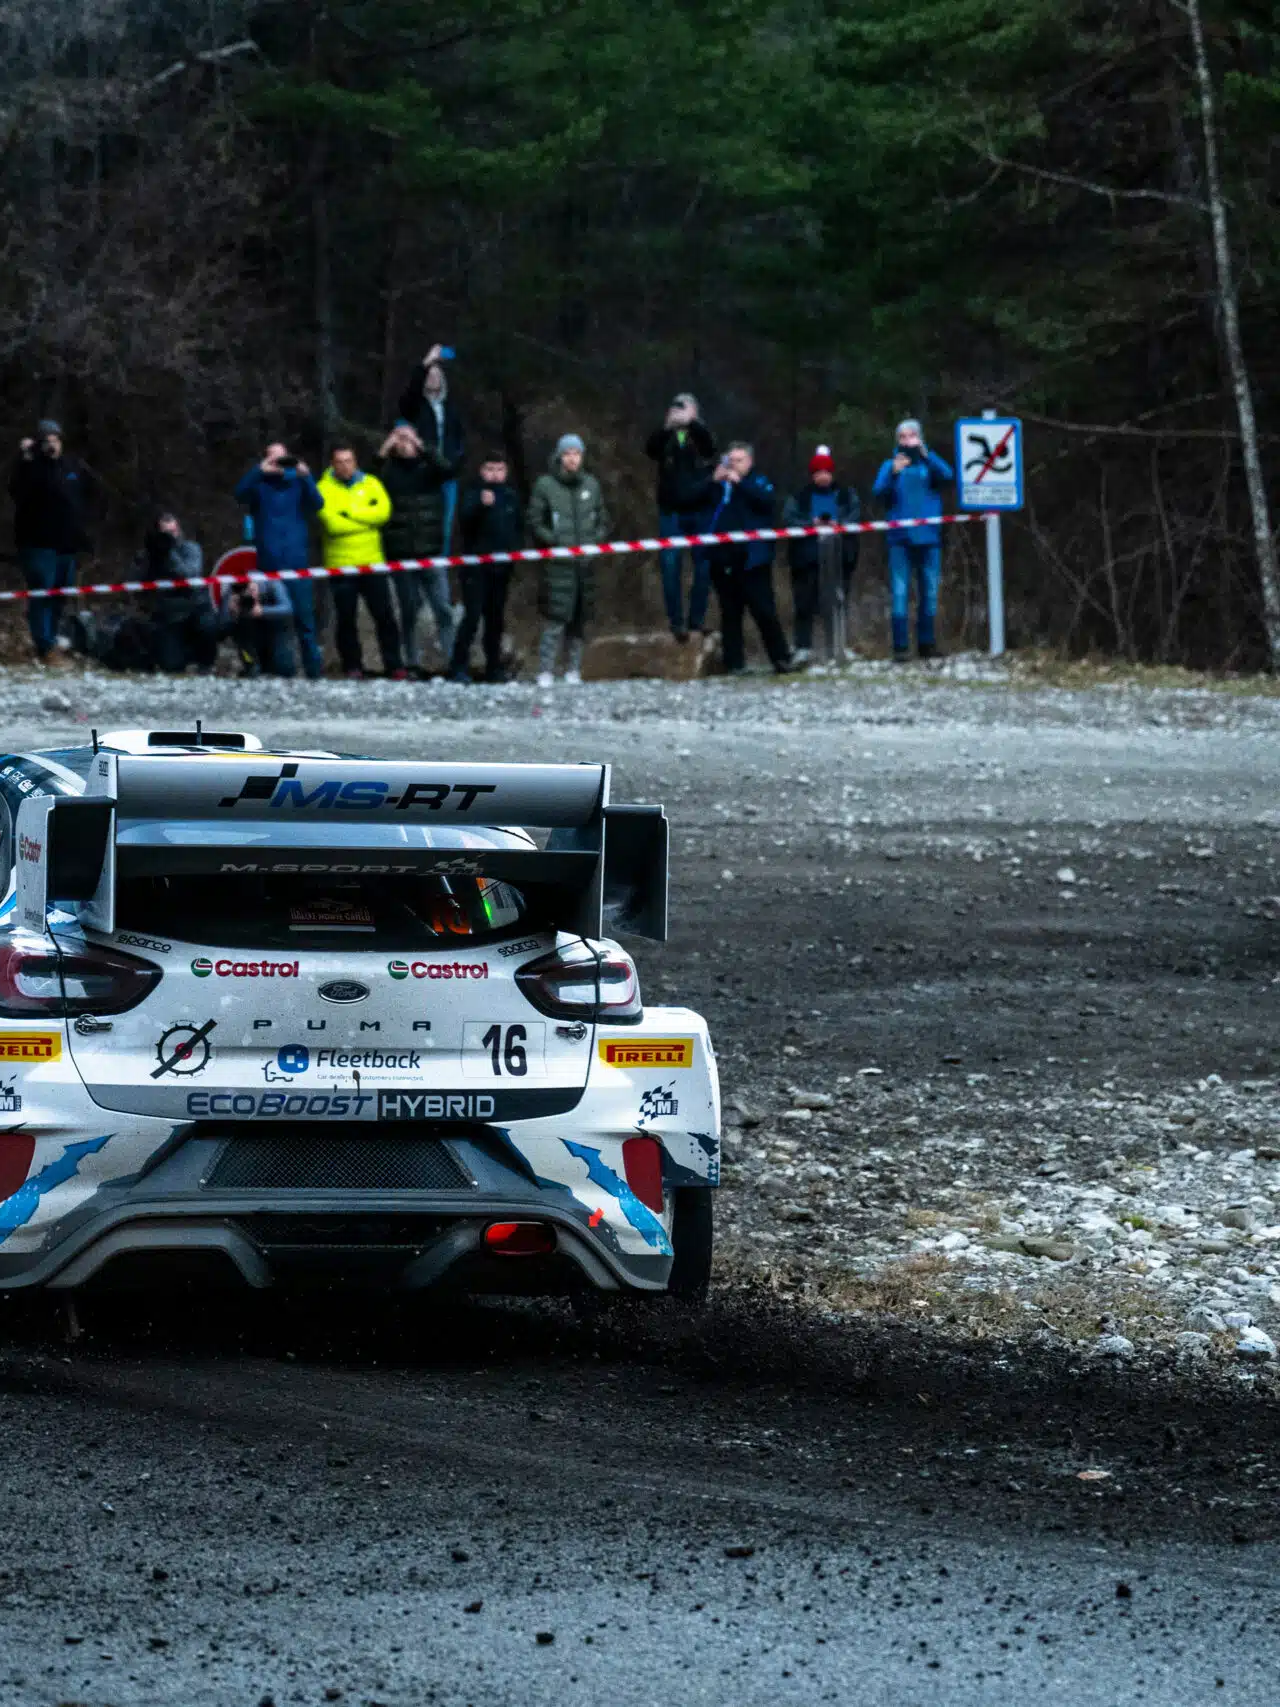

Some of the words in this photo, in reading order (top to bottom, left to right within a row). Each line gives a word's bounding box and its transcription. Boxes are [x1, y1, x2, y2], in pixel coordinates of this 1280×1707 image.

[270, 780, 497, 811] MS-RT
[220, 863, 417, 874] M-SPORT
[117, 934, 172, 951] sparco
[497, 939, 539, 955] sparco
[215, 959, 299, 978] Castrol
[411, 961, 489, 979] Castrol
[317, 1050, 421, 1069] Fleetback
[481, 1024, 528, 1077] 16
[606, 1044, 686, 1063] PIRELLI
[381, 1095, 495, 1118] HYBRID
